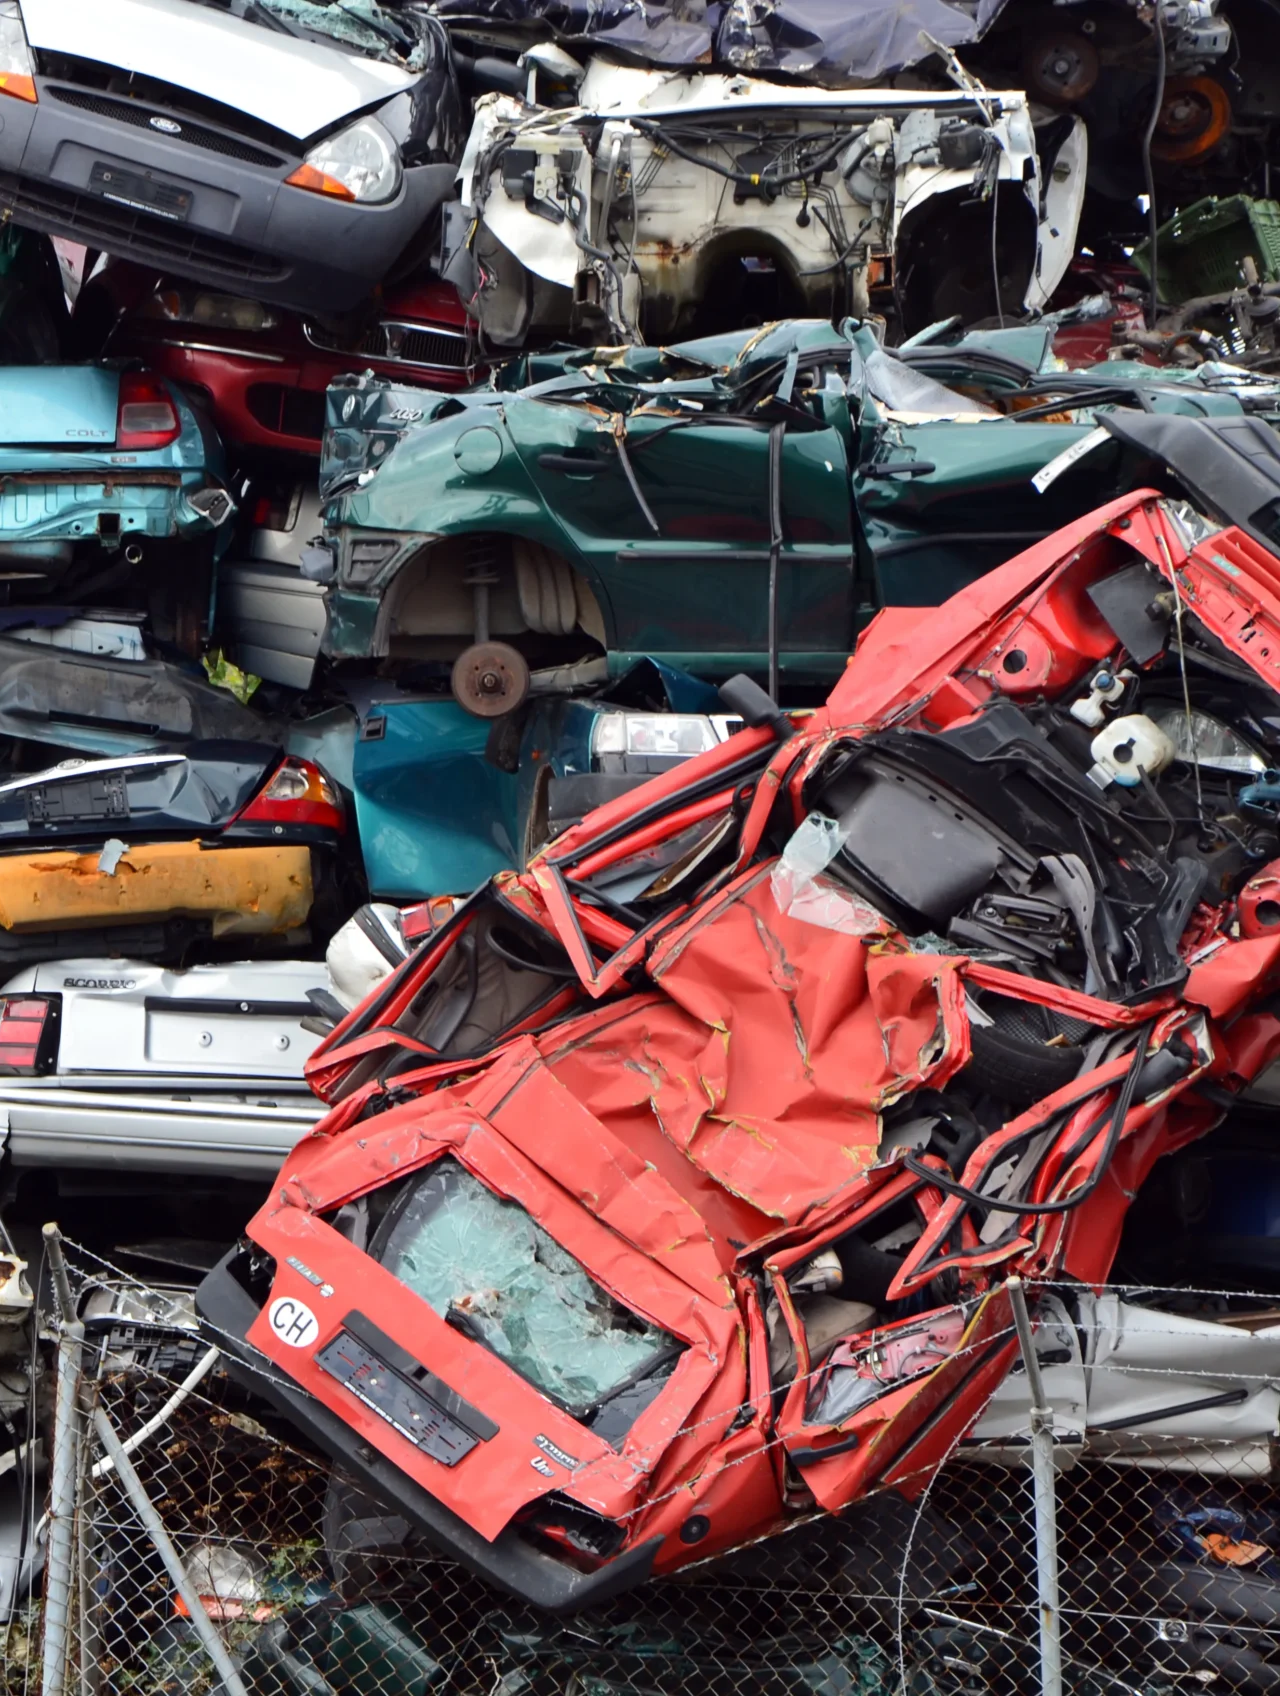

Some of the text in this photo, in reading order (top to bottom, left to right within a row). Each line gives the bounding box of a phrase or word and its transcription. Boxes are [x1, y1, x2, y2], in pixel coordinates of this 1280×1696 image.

[65, 429, 109, 437] COLT
[63, 977, 136, 989] SCORPIO
[273, 1302, 313, 1344] CH
[530, 1456, 555, 1477] Uno
